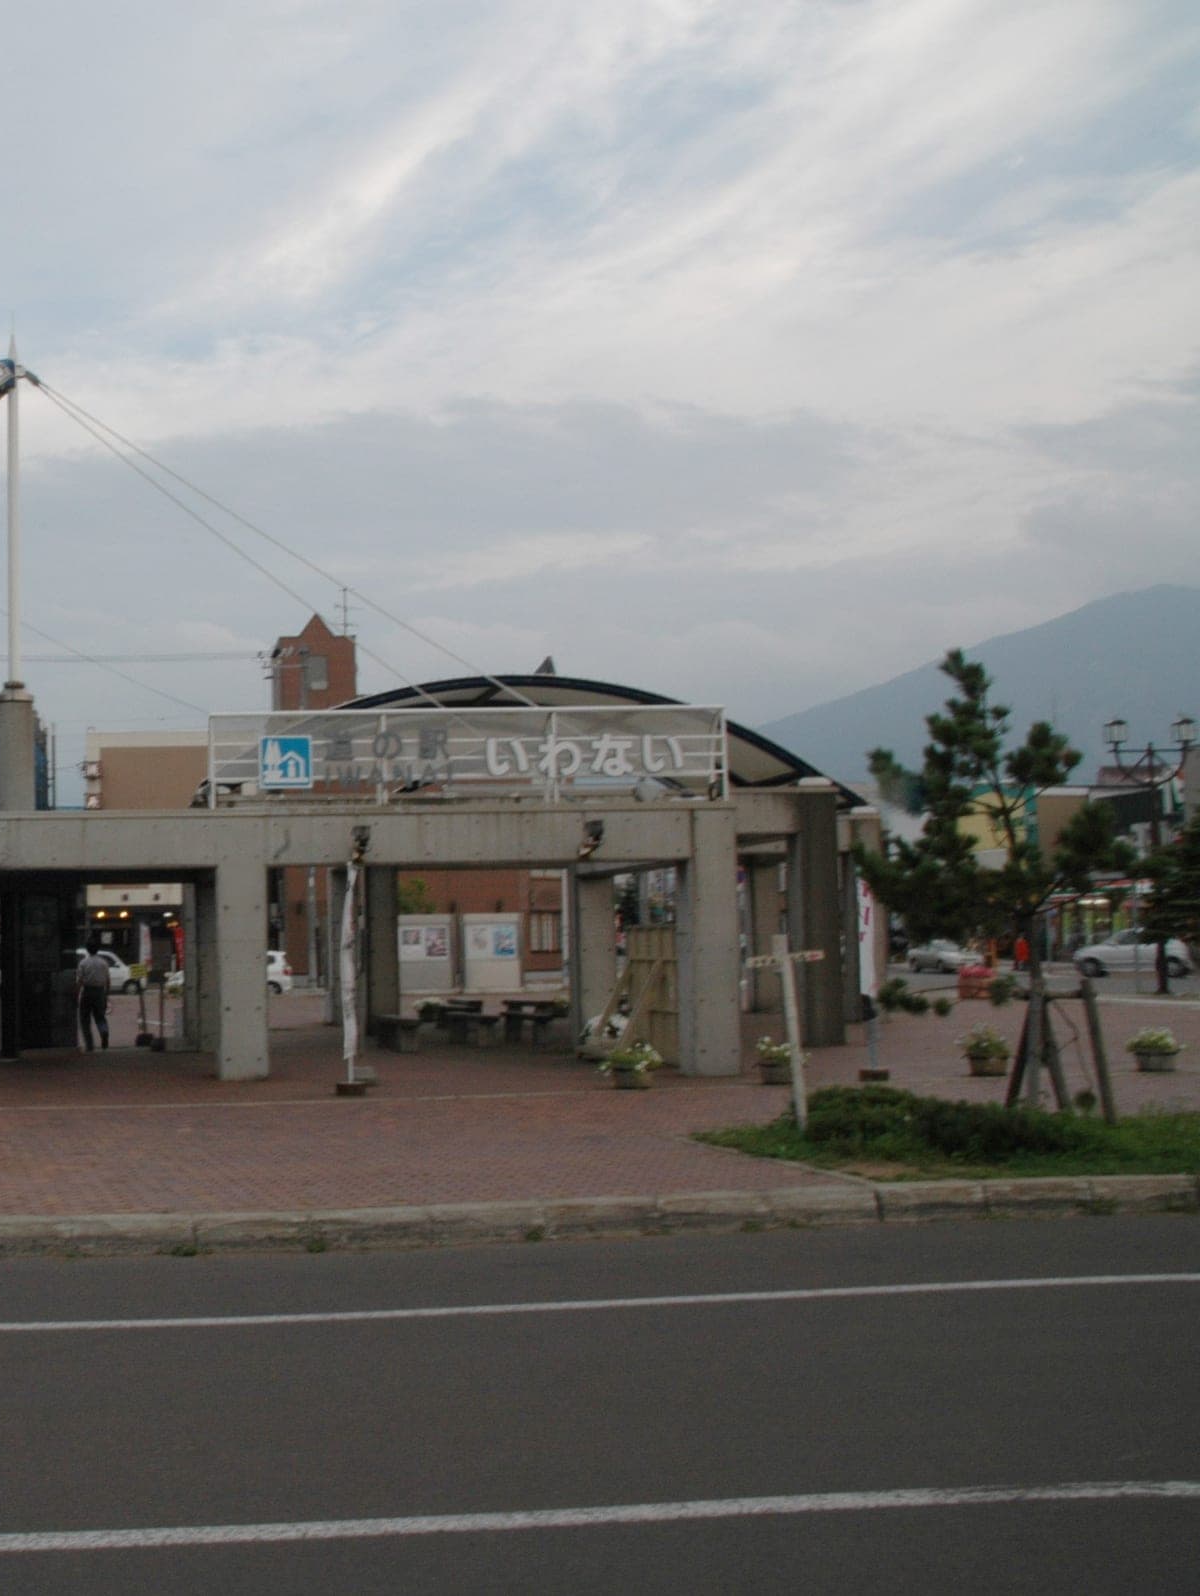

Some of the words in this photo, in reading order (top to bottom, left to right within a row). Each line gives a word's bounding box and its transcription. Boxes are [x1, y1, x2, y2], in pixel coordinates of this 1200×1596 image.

[324, 728, 452, 761] 道の駅
[484, 733, 686, 778] いわない
